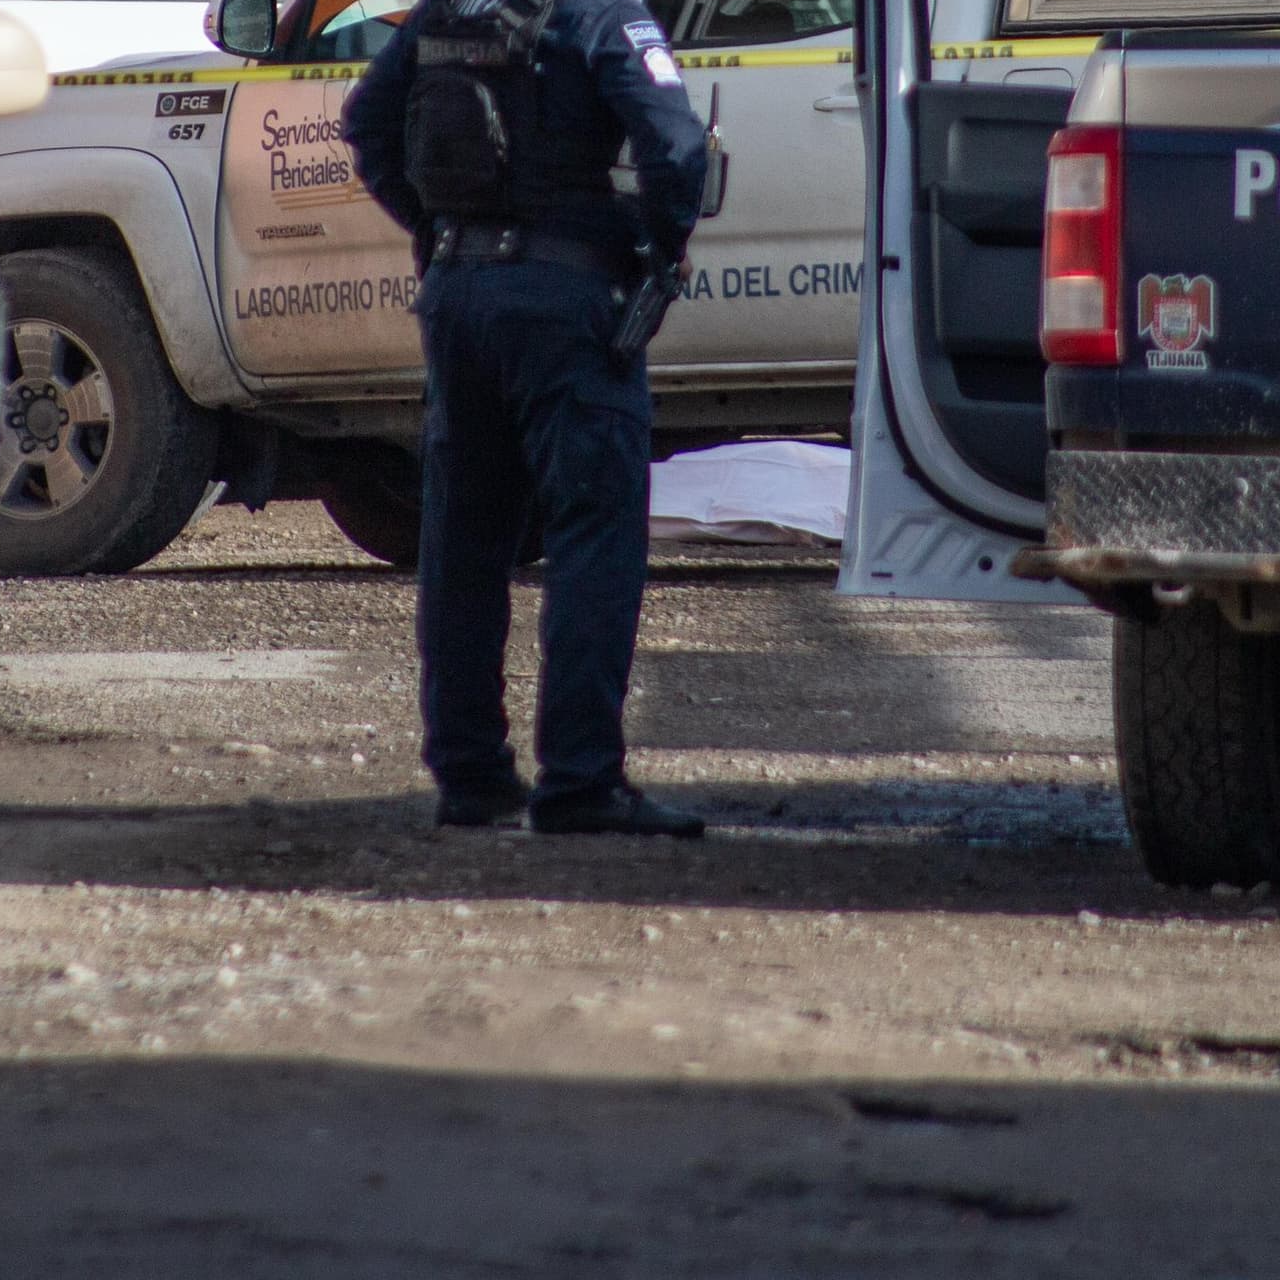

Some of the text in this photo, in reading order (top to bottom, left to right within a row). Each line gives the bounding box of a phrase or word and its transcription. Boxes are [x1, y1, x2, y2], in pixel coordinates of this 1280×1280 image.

[179, 96, 210, 111] FGE
[168, 123, 206, 141] 657
[261, 109, 342, 151] Servicios
[271, 151, 350, 191] Periciales
[235, 278, 374, 320] LABORATORIO
[722, 266, 781, 299] DEL
[1147, 351, 1205, 367] TIJUANA
